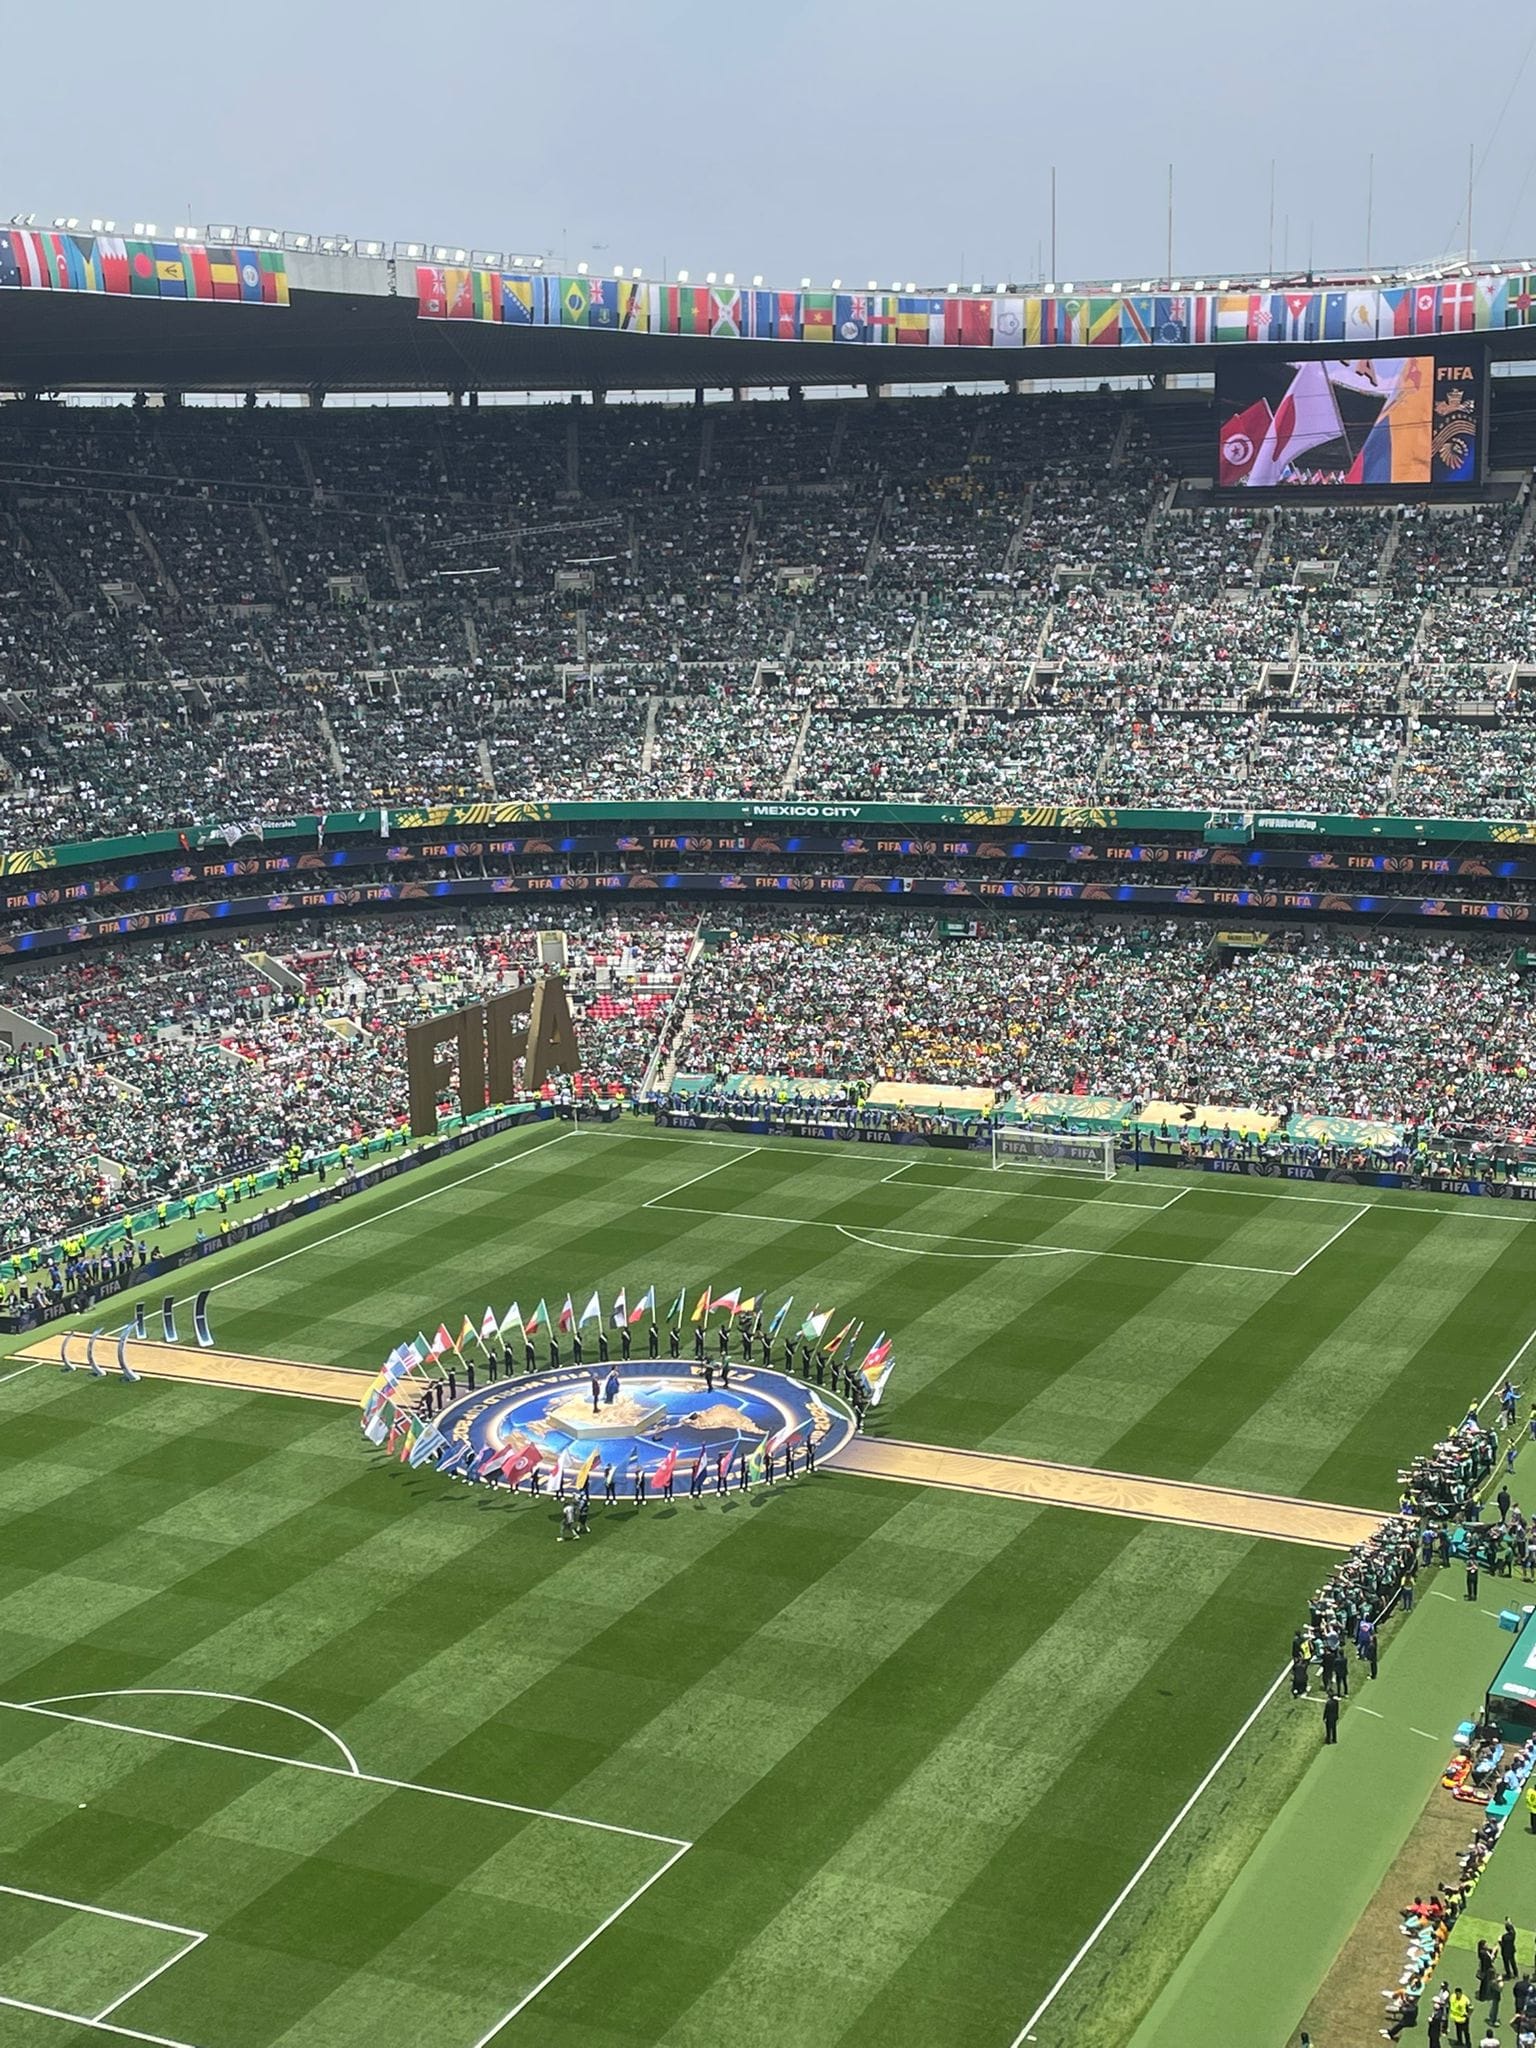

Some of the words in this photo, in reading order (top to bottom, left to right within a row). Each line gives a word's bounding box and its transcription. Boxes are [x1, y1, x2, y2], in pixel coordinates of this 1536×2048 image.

[1437, 366, 1474, 381] FIFA
[754, 806, 818, 816] MEXICO
[822, 807, 861, 817] CITY
[7, 895, 29, 908] FIFA
[65, 884, 88, 899] FIFA
[203, 864, 227, 876] FIFA
[265, 857, 290, 870] FIFA
[422, 845, 448, 857] FIFA
[489, 841, 515, 853] FIFA
[653, 838, 677, 850] FIFA
[719, 839, 737, 850] FIF
[878, 841, 902, 853] FIFA
[943, 843, 969, 855] FIFA
[1107, 847, 1132, 859] FIFA
[1348, 856, 1375, 869] FIFA
[1421, 859, 1449, 872] FIFA
[99, 921, 121, 934] FIFA
[155, 911, 177, 924] FIFA
[303, 894, 327, 905] FIFA
[367, 887, 392, 900] FIFA
[528, 878, 553, 890] FIFA
[595, 876, 621, 887] FIFA
[756, 877, 780, 888] FIFA
[820, 878, 845, 889] FIFA
[980, 883, 1005, 895] FIFA
[1047, 886, 1073, 897] FIFA
[1214, 892, 1239, 904] FIFA
[1284, 895, 1312, 906] FIFA
[1461, 904, 1489, 917] FIFA
[407, 975, 582, 1137] FIFA
[673, 1116, 697, 1128] FIFA
[801, 1126, 826, 1137] FIFA
[866, 1131, 892, 1143] FIFA
[1002, 1141, 1028, 1153] FIFA
[1071, 1147, 1097, 1160] FIFA
[1213, 1160, 1241, 1173] FIFA
[1287, 1168, 1315, 1180] FIFA
[1441, 1181, 1471, 1194] FIFA
[44, 1303, 66, 1321] FIFA
[100, 1280, 121, 1297] FIFA
[203, 1239, 223, 1254] FIFA
[252, 1219, 270, 1234] FIFA
[542, 1371, 591, 1384] FIFA
[483, 1379, 545, 1405] WORLD
[463, 1404, 488, 1420] CUP
[453, 1419, 473, 1443] 202
